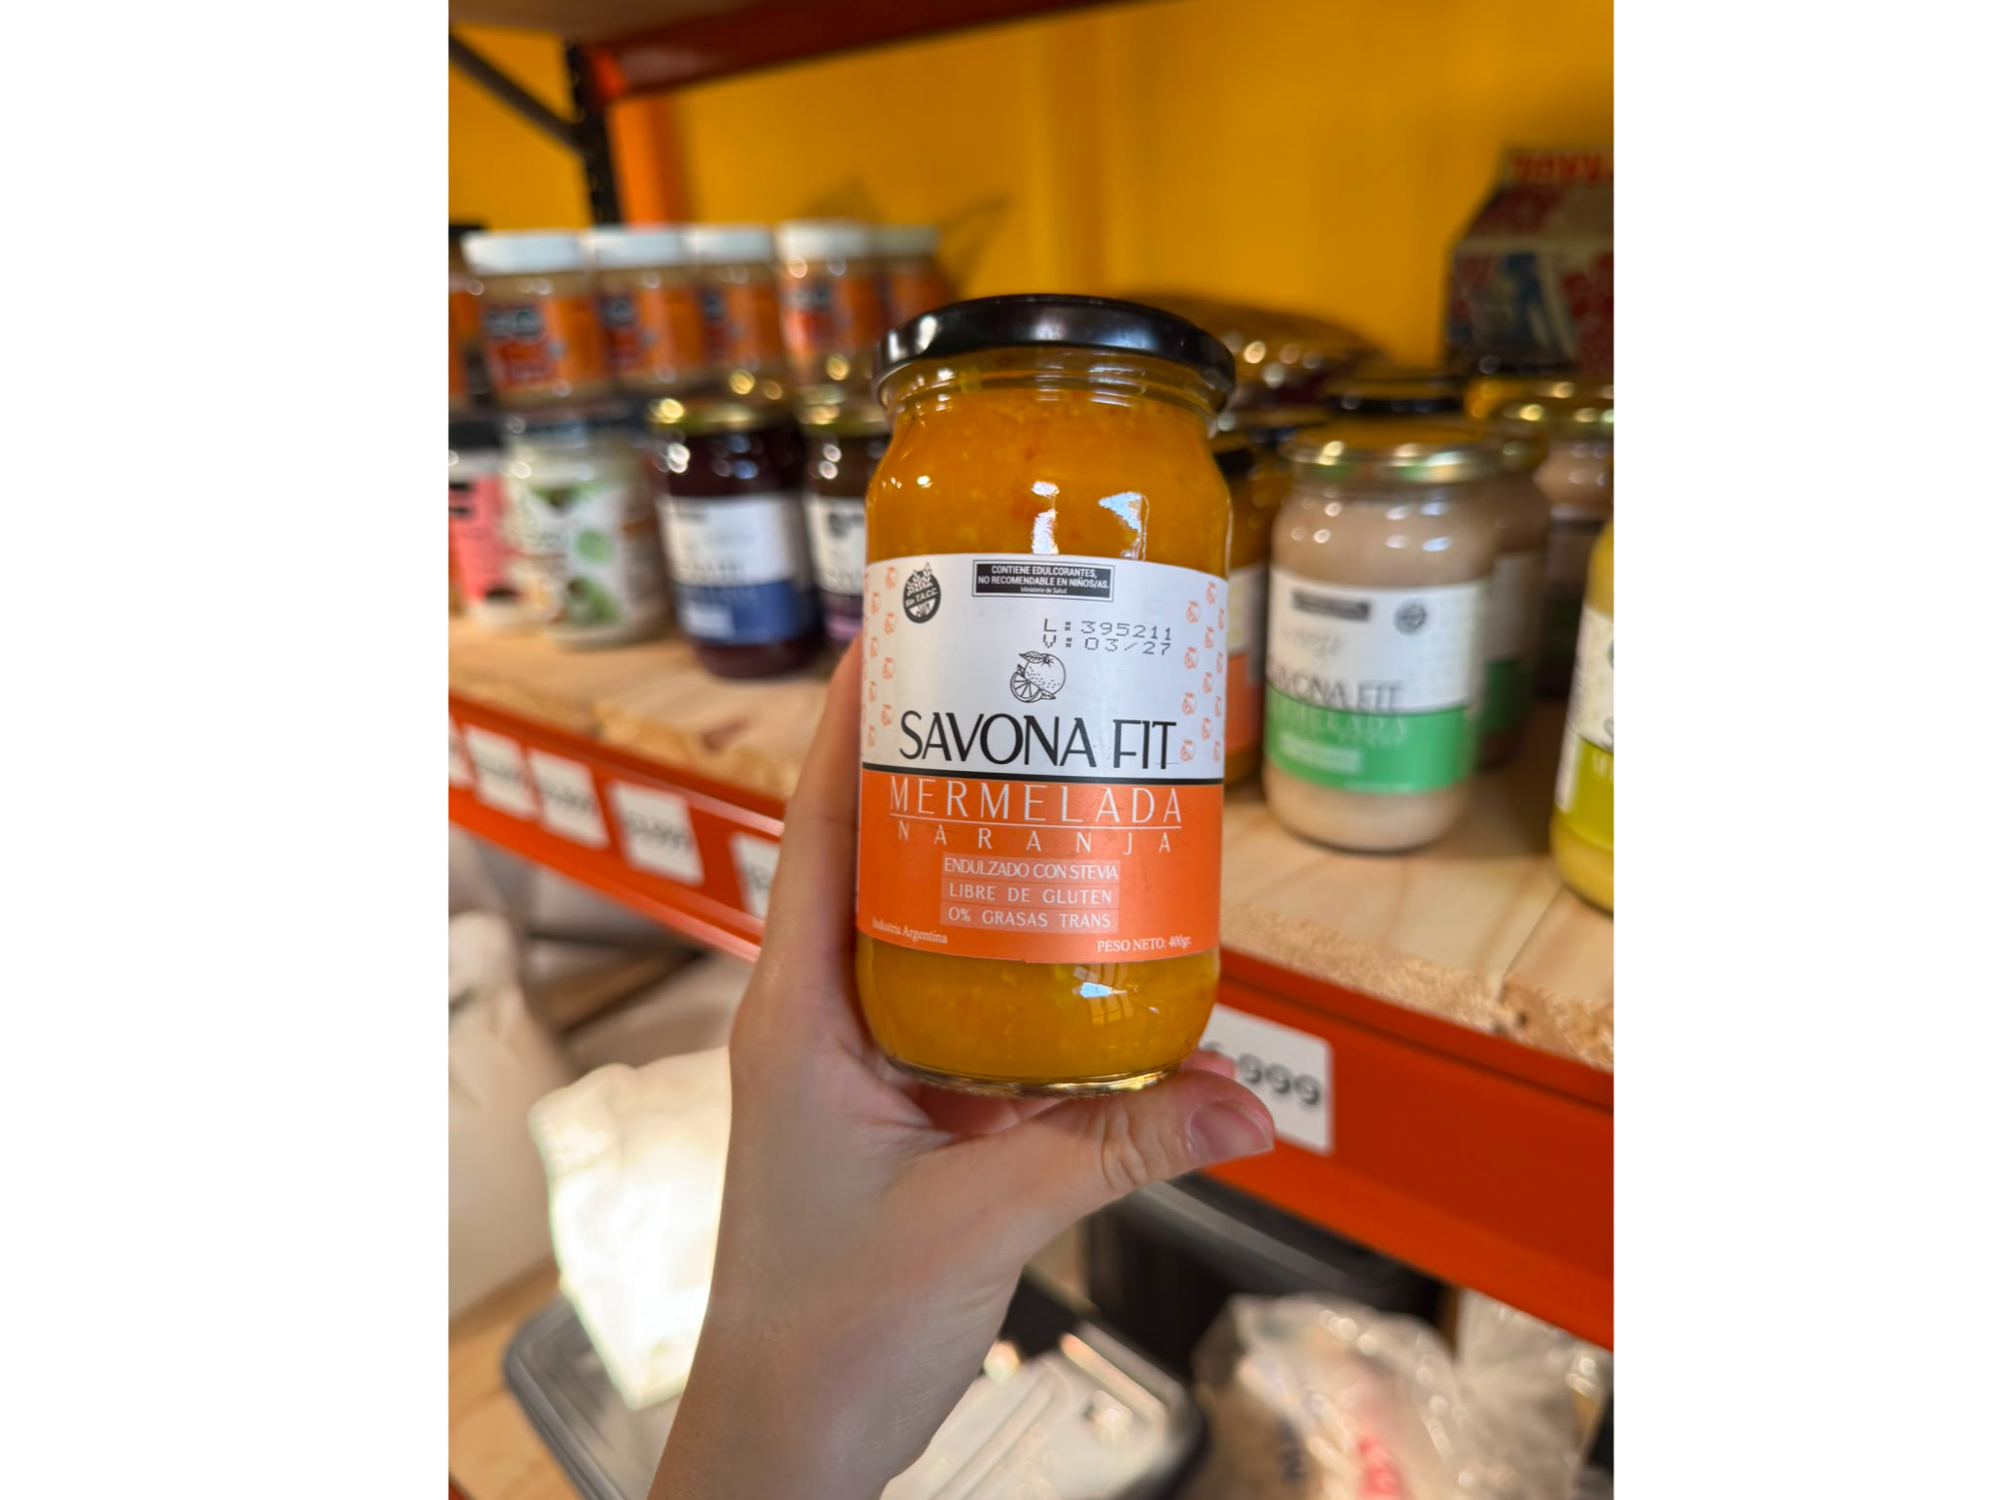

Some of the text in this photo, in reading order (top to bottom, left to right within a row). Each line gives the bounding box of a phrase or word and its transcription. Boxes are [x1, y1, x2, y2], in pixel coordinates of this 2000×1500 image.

[978, 575, 1109, 589] NO RECOMENDABLE EN NIÑOS/AS.
[991, 565, 1097, 579] CONTIENE EDULCORANTES,
[899, 710, 1177, 770] SAVONA FIT
[890, 775, 1182, 823] MERMELADA
[944, 858, 1118, 880] ENDULZADO CON STEVIA
[949, 882, 1112, 904] LIBRE DE GLUTEN
[948, 906, 1111, 929] 0% GRASAS TRANS
[872, 916, 948, 943] Industria Argentina
[1096, 938, 1130, 953] PESO
[1133, 937, 1167, 951] NETO:
